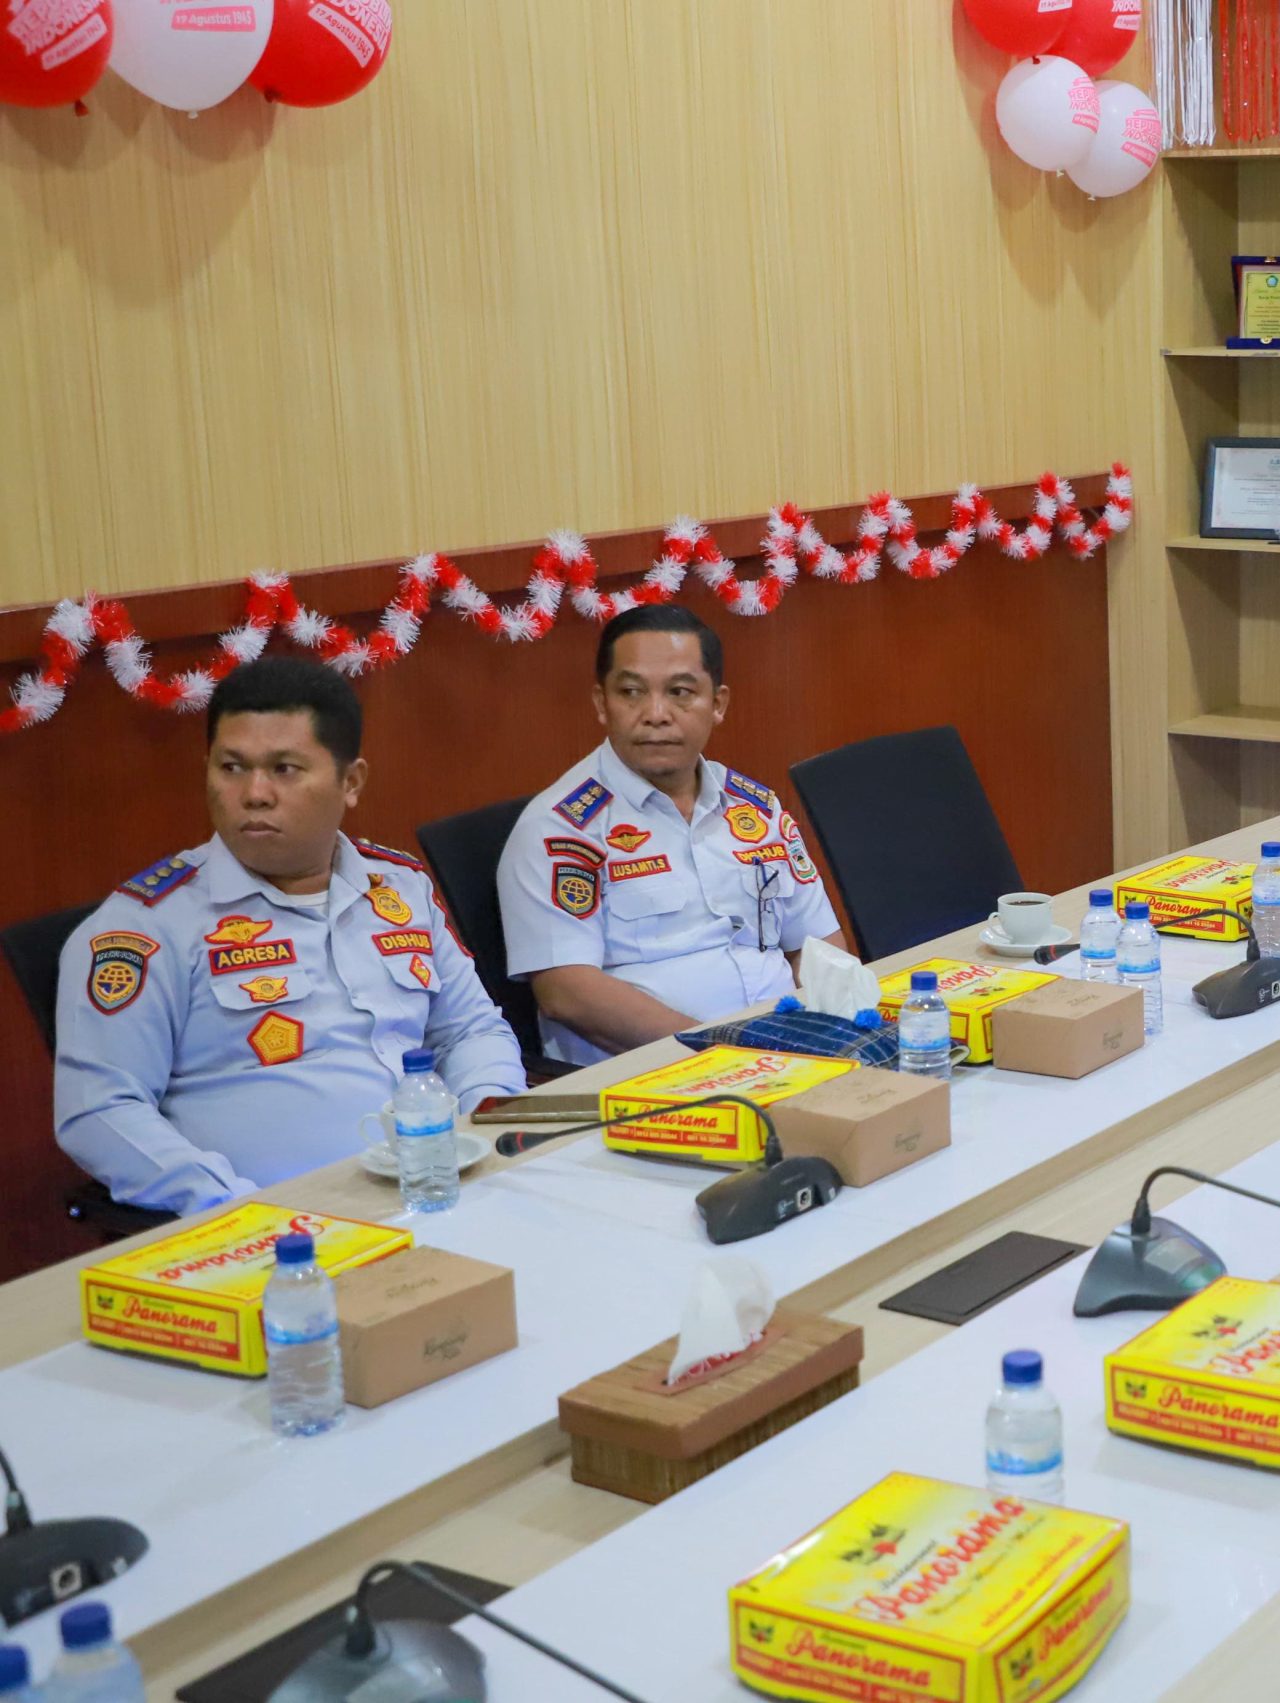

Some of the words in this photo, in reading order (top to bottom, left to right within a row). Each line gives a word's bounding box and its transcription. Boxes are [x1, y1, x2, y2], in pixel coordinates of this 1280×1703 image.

[217, 943, 291, 969] AGRESA
[380, 933, 431, 950] DISHUB
[123, 1296, 217, 1333] Panorama
[1158, 1385, 1280, 1429] Panorama
[860, 1496, 1025, 1620] Panorama
[785, 1627, 930, 1687] Panorama
